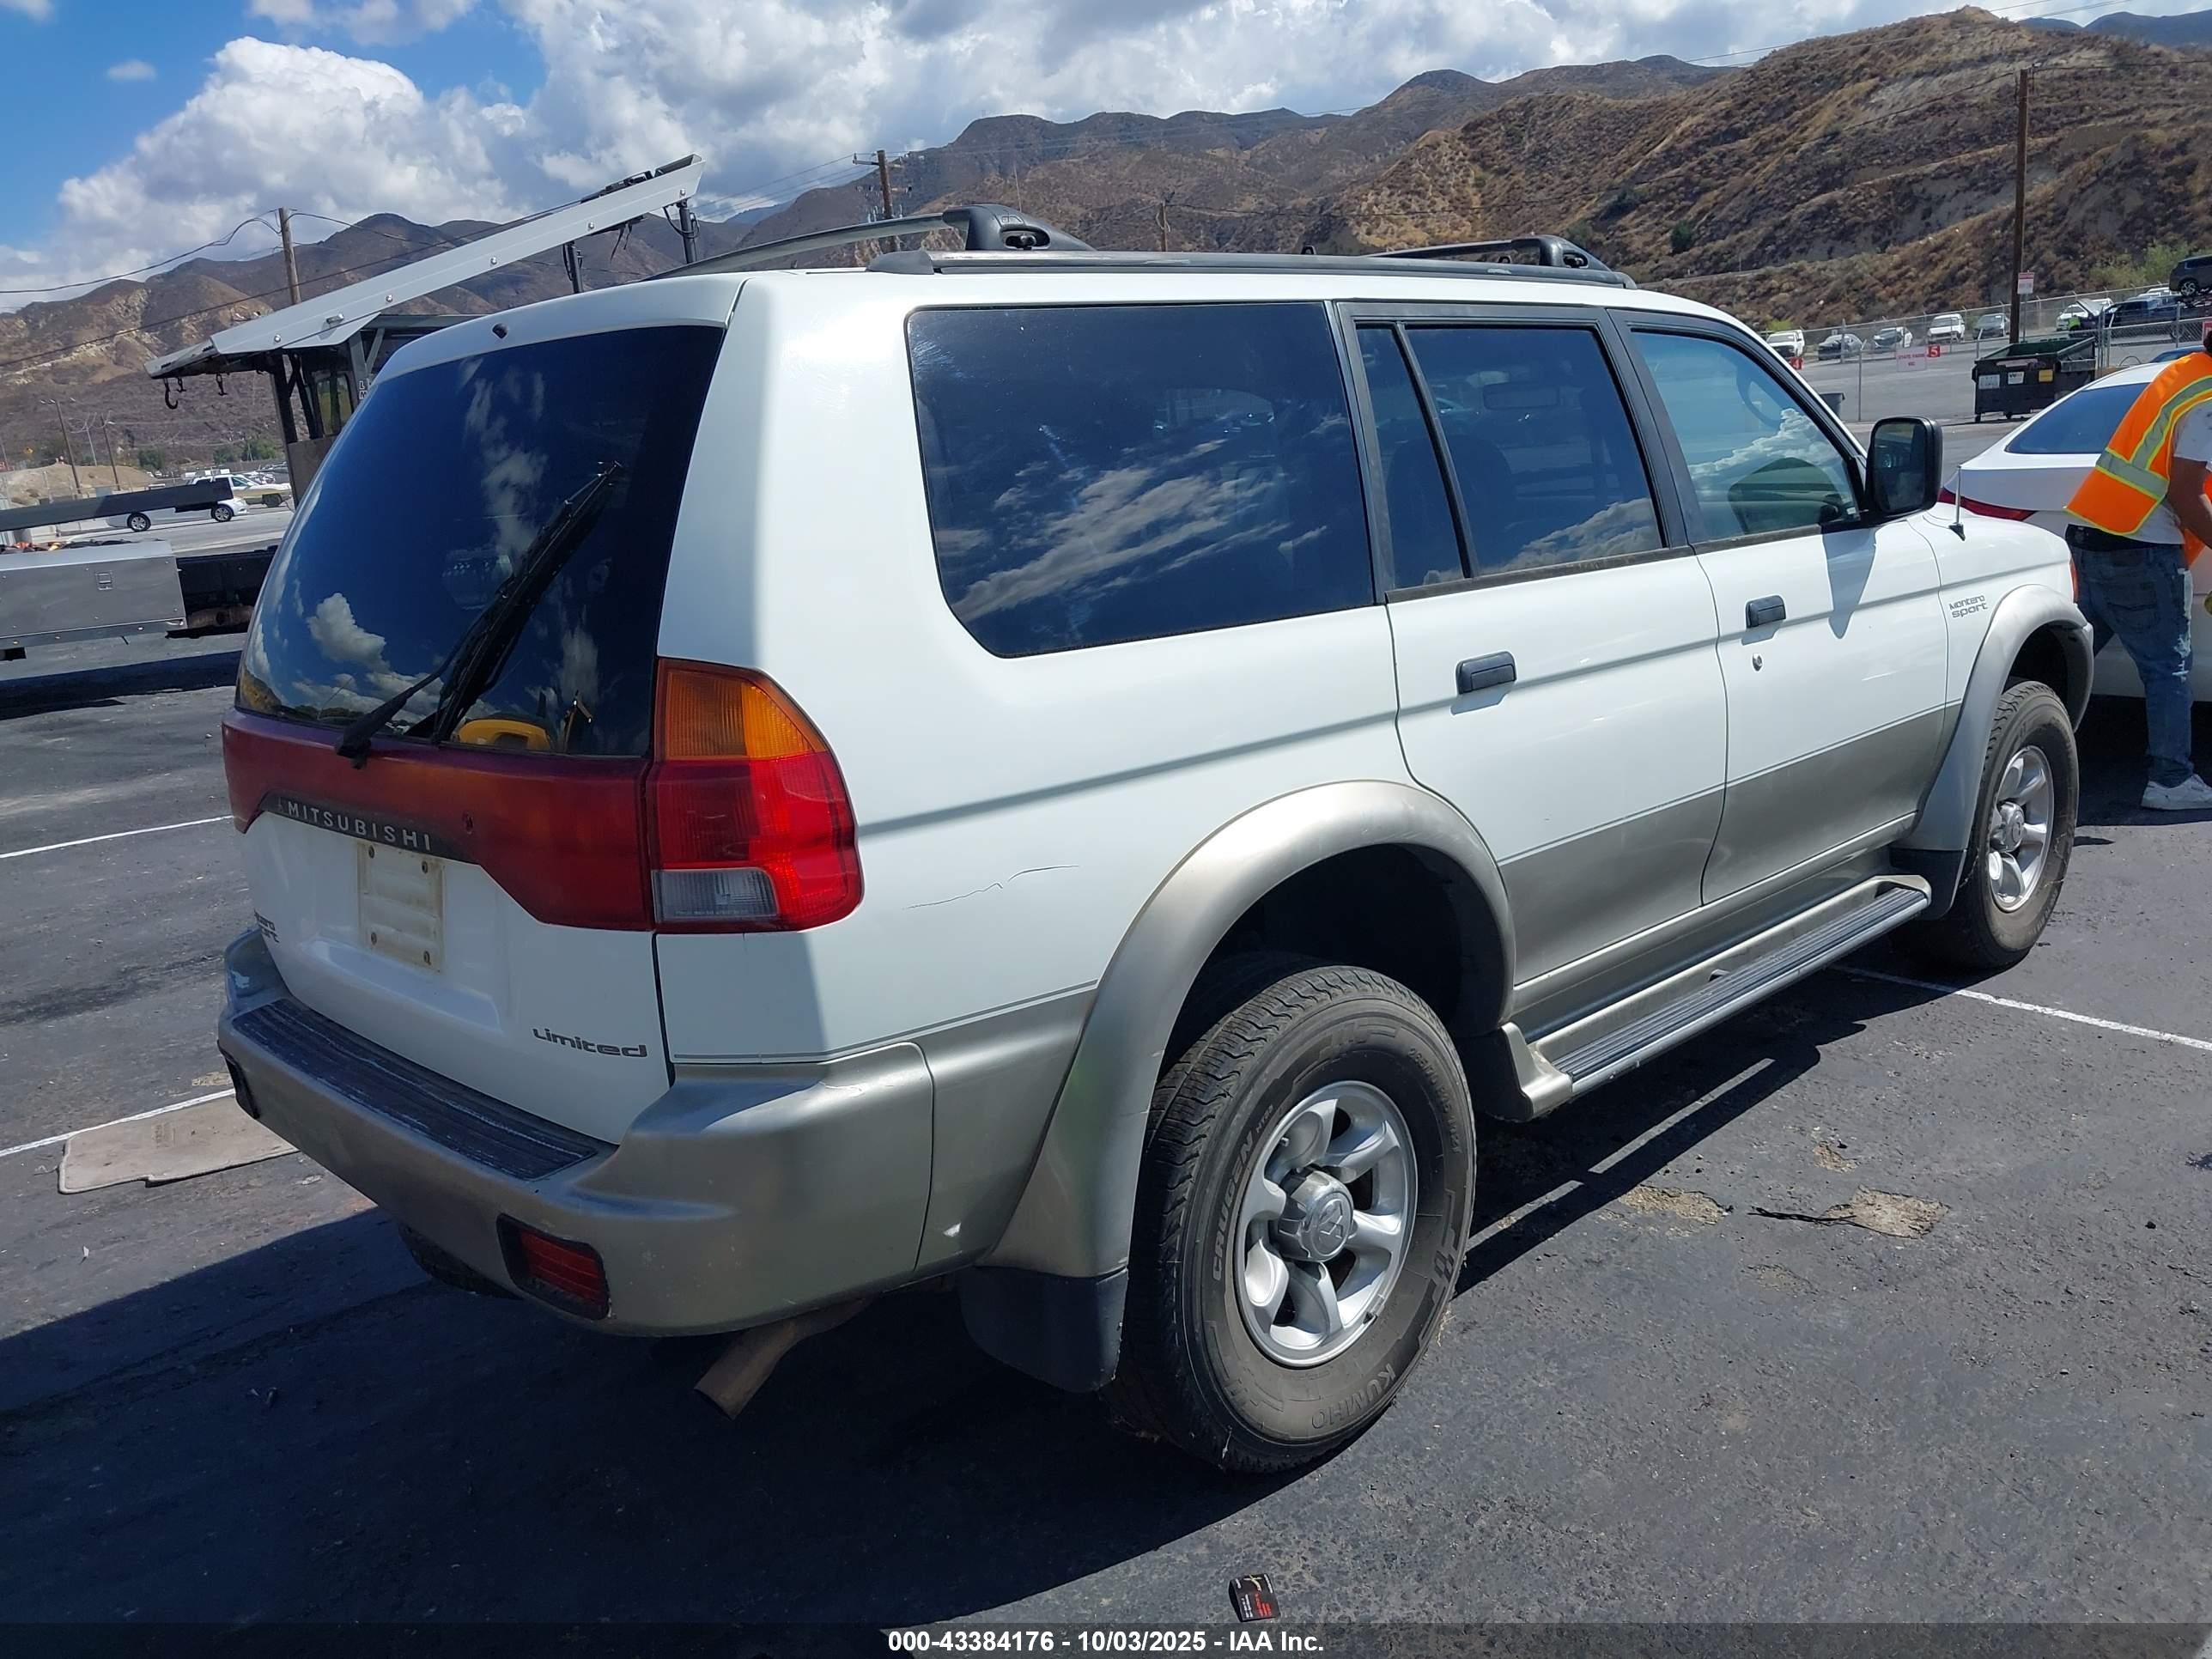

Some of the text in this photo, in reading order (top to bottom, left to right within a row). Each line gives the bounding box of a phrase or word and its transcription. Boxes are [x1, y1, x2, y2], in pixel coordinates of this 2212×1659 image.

[1930, 345, 1938, 357] 5
[288, 800, 431, 852] MITSUBISHI
[532, 1028, 648, 1058] Limited
[1311, 1363, 1397, 1430] KUMHO
